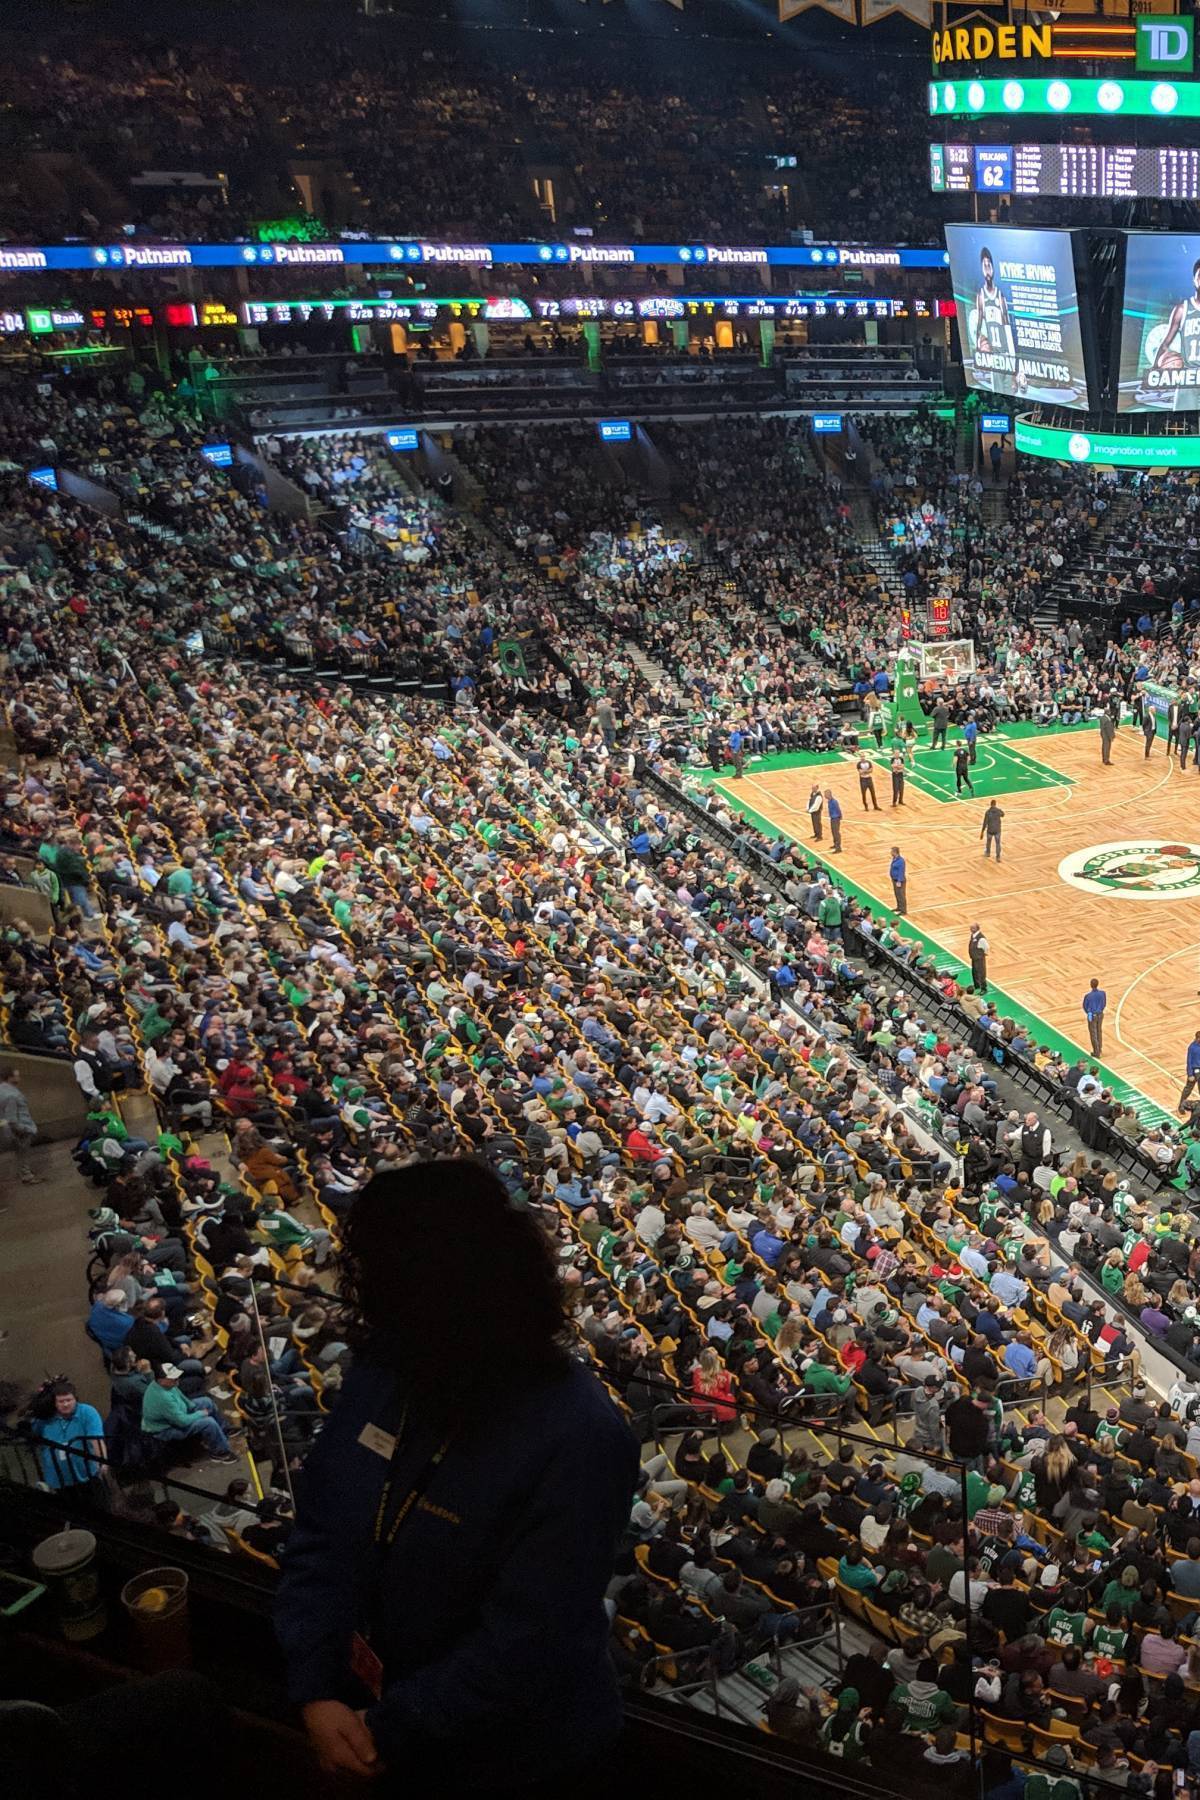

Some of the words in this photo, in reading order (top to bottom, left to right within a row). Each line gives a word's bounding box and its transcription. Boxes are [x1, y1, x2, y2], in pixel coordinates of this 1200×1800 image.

[932, 25, 1052, 64] GARDEN
[1141, 24, 1188, 60] TD
[983, 166, 1004, 187] 62
[125, 248, 192, 266] Putnam
[275, 247, 344, 263] Putnam
[423, 246, 492, 262] Putnam
[571, 247, 634, 262] Putnam
[708, 248, 767, 263] Putnam
[840, 249, 900, 265] Putnam
[999, 262, 1026, 280] KYRIE
[1027, 264, 1057, 282] IRVING
[254, 312, 268, 321] 35
[278, 311, 291, 321] 12
[303, 311, 310, 320] 7
[326, 311, 333, 320] 7
[379, 309, 411, 318] 29/64
[424, 309, 437, 318] 45
[540, 302, 559, 315] 72
[575, 299, 605, 310] 5:21
[614, 302, 633, 315] 62
[749, 306, 774, 314] 25/55
[786, 306, 807, 314] 6/16
[816, 306, 826, 314] 10
[838, 306, 845, 314] 6
[858, 306, 868, 314] 19
[877, 306, 887, 314] 26
[32, 316, 49, 329] TD
[52, 312, 84, 325] Bank
[990, 326, 1002, 348] 11
[1025, 328, 1048, 341] POINTS
[1048, 330, 1062, 343] AND
[975, 352, 1016, 373] GAMEDAY
[1018, 359, 1071, 382] ANALYTICS
[611, 425, 629, 433] TUFTS
[398, 434, 416, 442] TUFTS
[1094, 445, 1142, 457] imagination
[1144, 446, 1154, 456] at
[1155, 446, 1178, 456] work
[1091, 847, 1156, 866] BOSTON
[1172, 1400, 1181, 1412] 0
[983, 1545, 999, 1561] TATUM
[1055, 1620, 1073, 1630] PIERCE
[1050, 1627, 1074, 1645] 34
